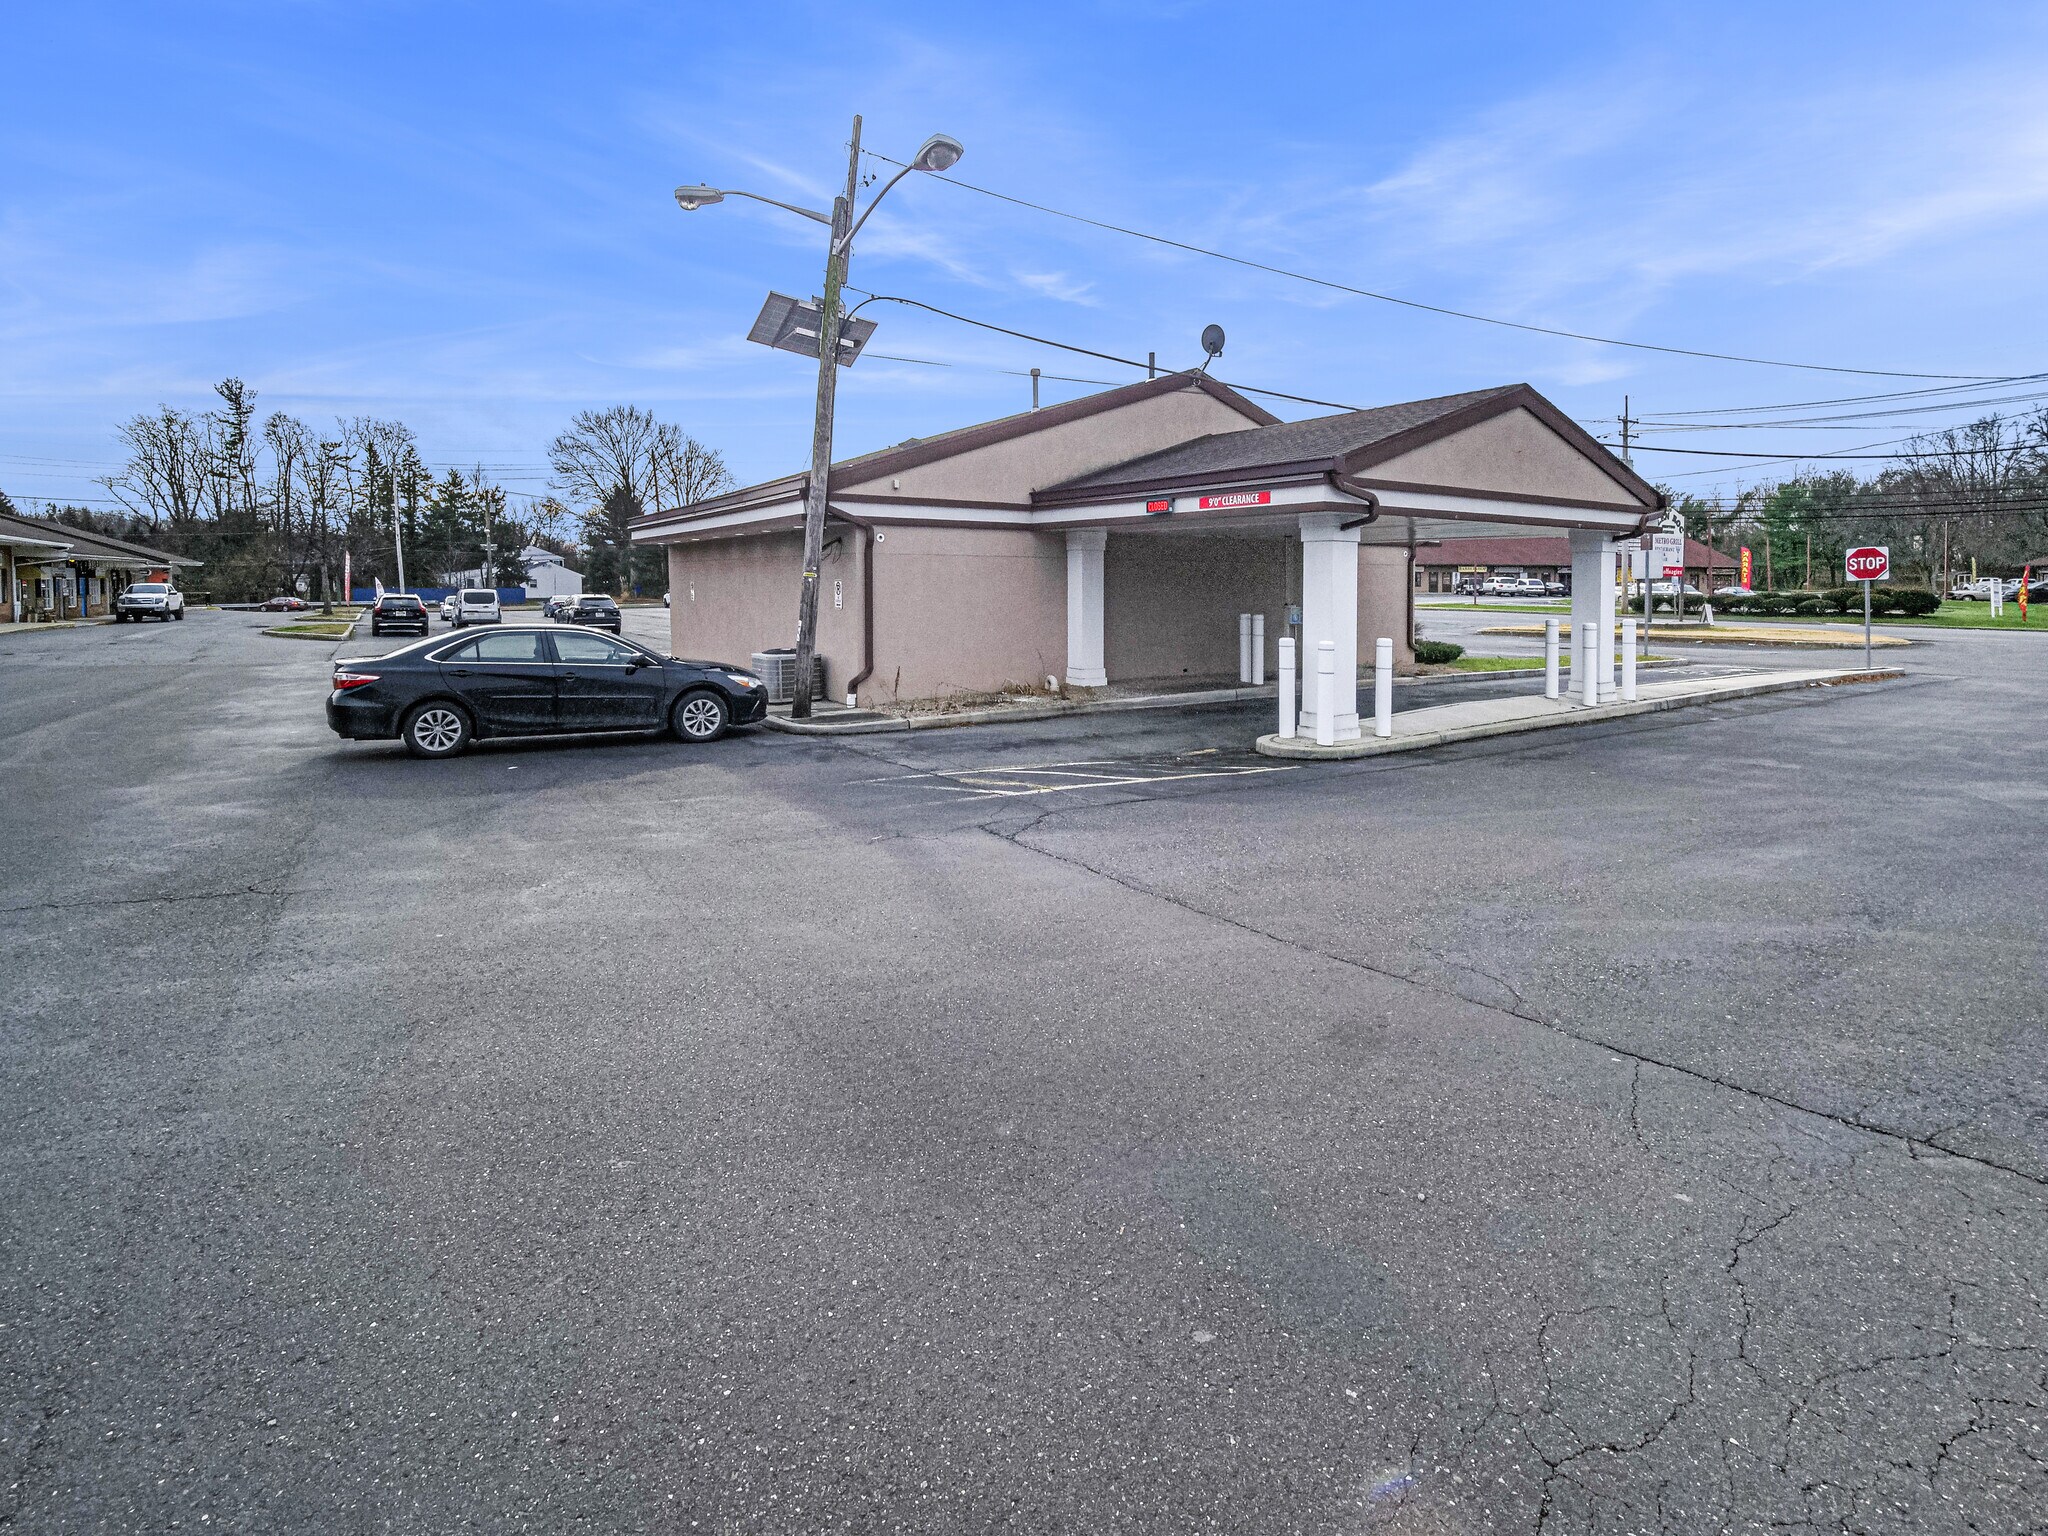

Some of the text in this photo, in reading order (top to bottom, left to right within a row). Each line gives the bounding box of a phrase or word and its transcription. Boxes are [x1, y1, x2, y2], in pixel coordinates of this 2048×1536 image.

[1222, 493, 1259, 505] CLEARANCE
[1148, 501, 1168, 511] CLOSED
[1849, 557, 1885, 570] STOP
